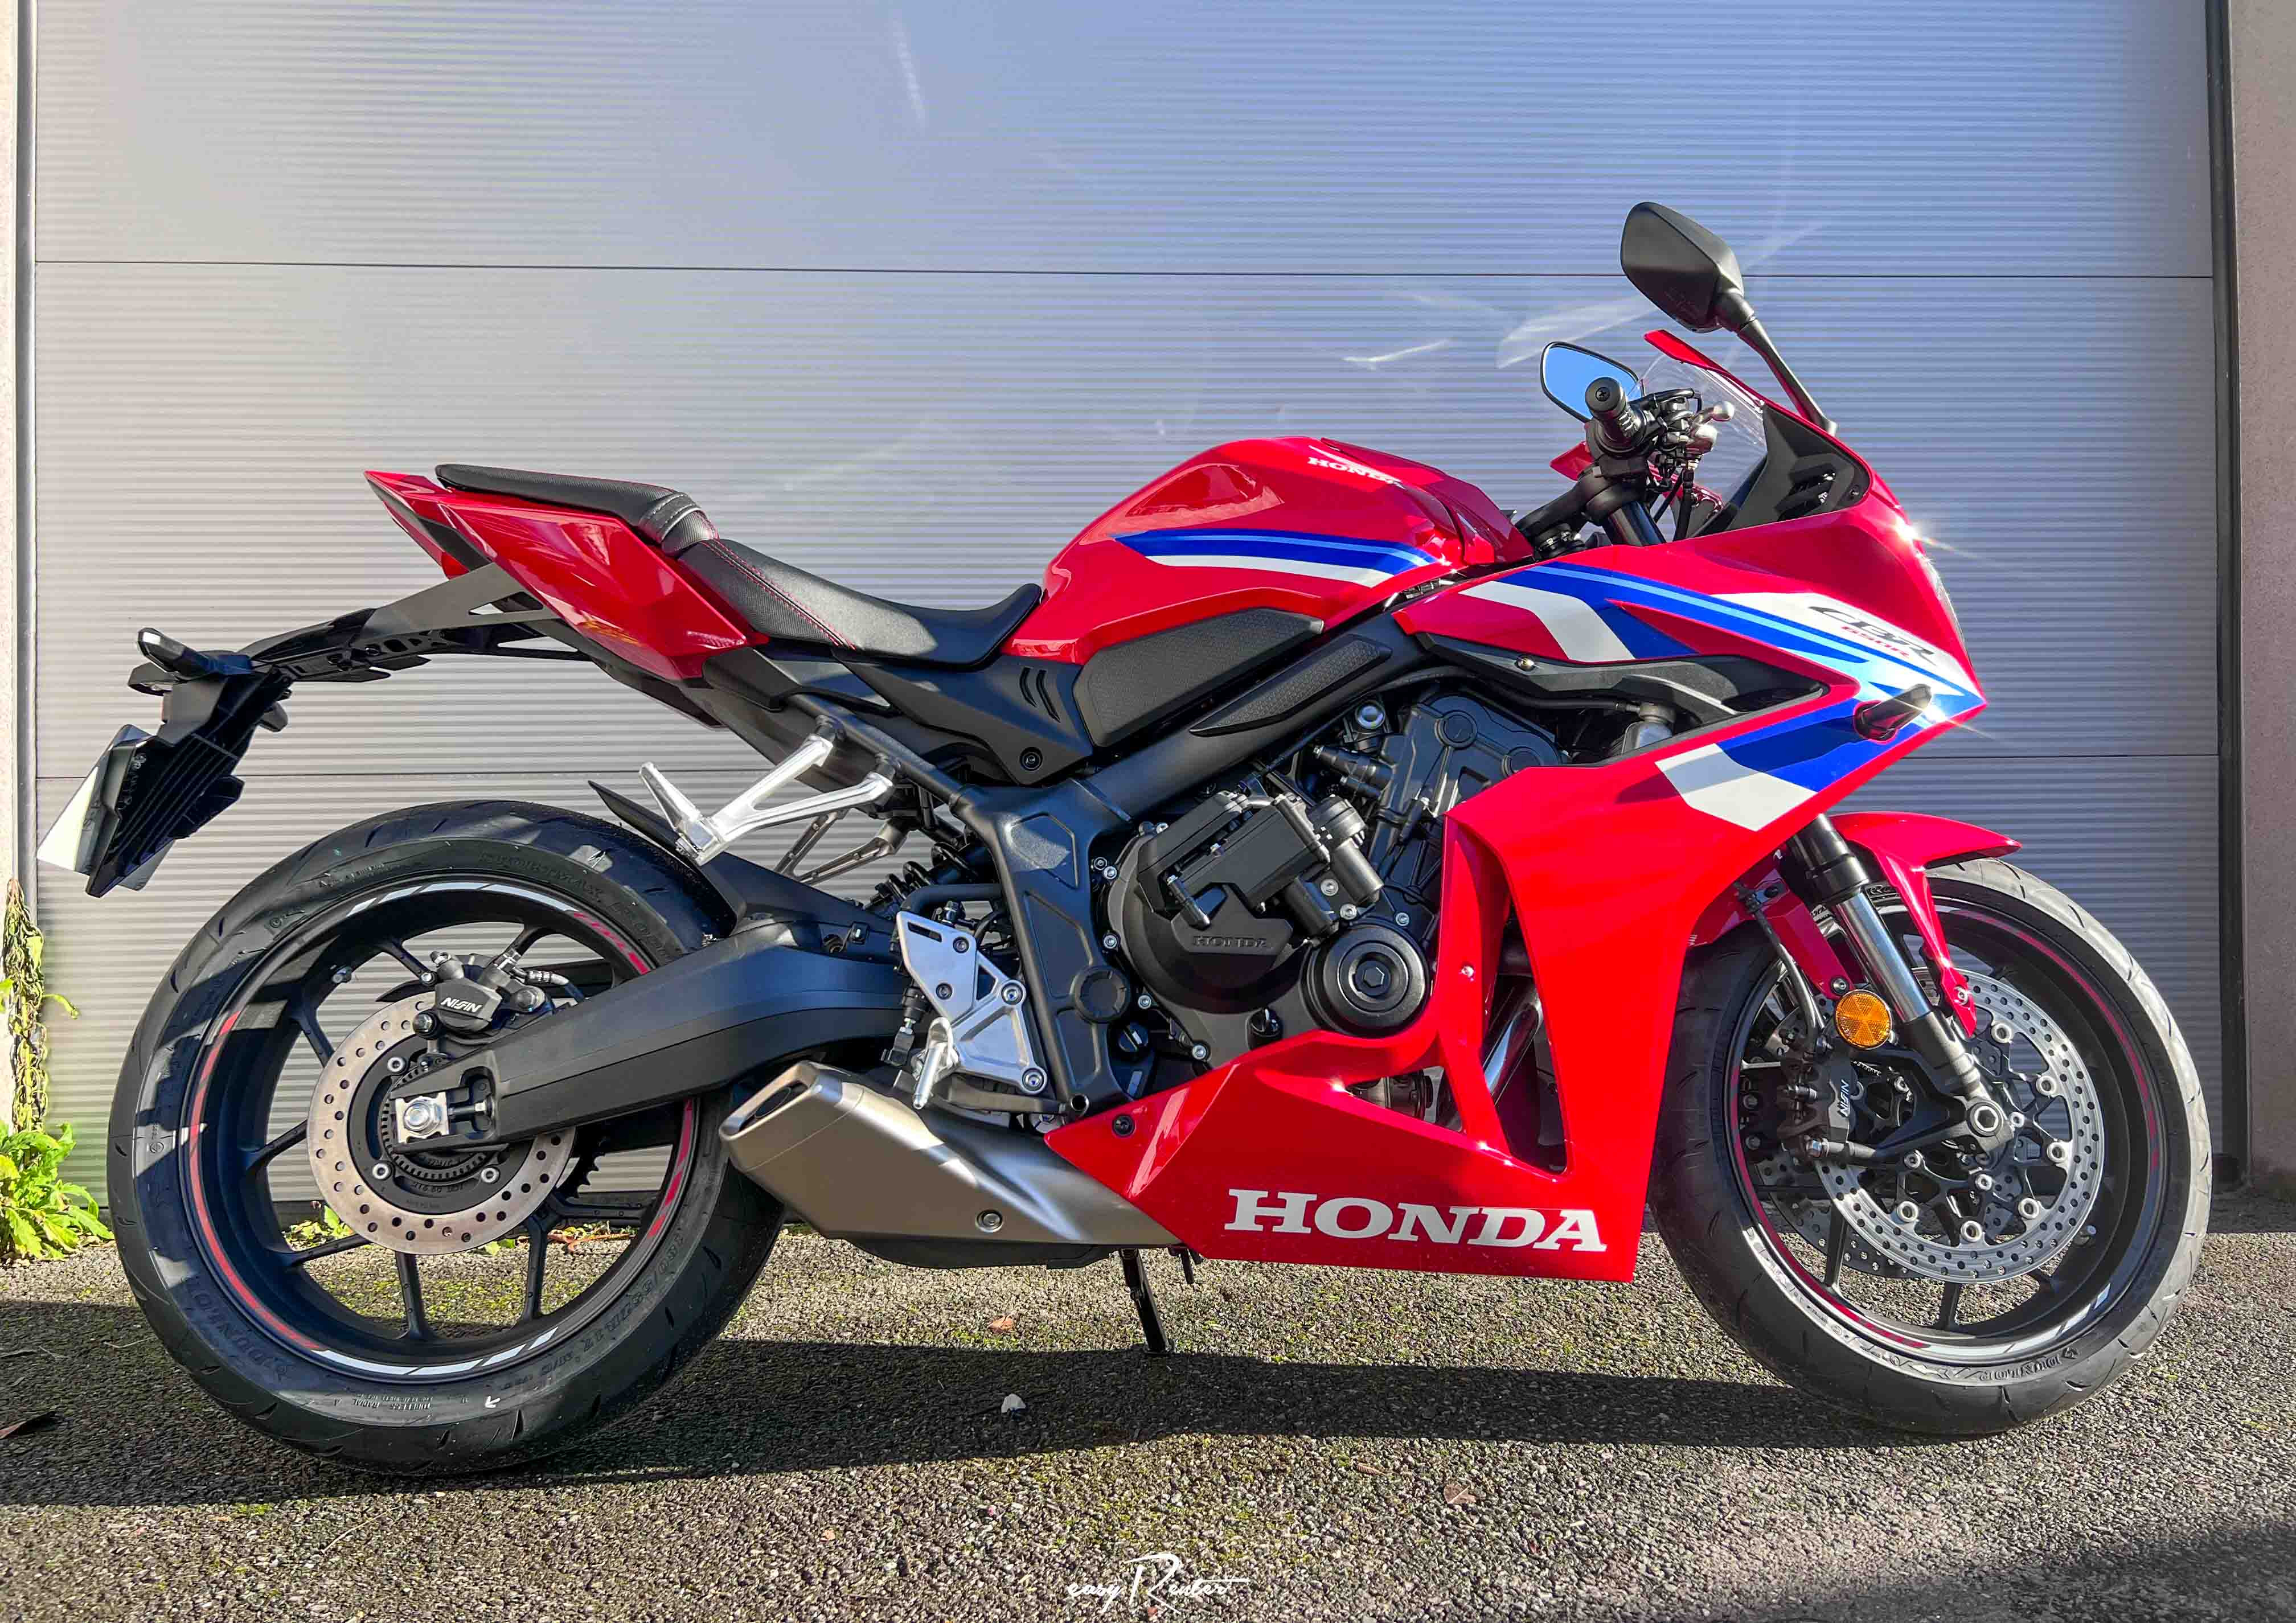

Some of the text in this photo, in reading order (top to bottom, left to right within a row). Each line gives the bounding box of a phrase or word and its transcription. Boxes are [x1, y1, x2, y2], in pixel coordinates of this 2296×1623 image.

[1807, 605, 1937, 667] CBR
[1224, 1189, 1607, 1252] HONDA
[1979, 1355, 2060, 1381] DUNLOP
